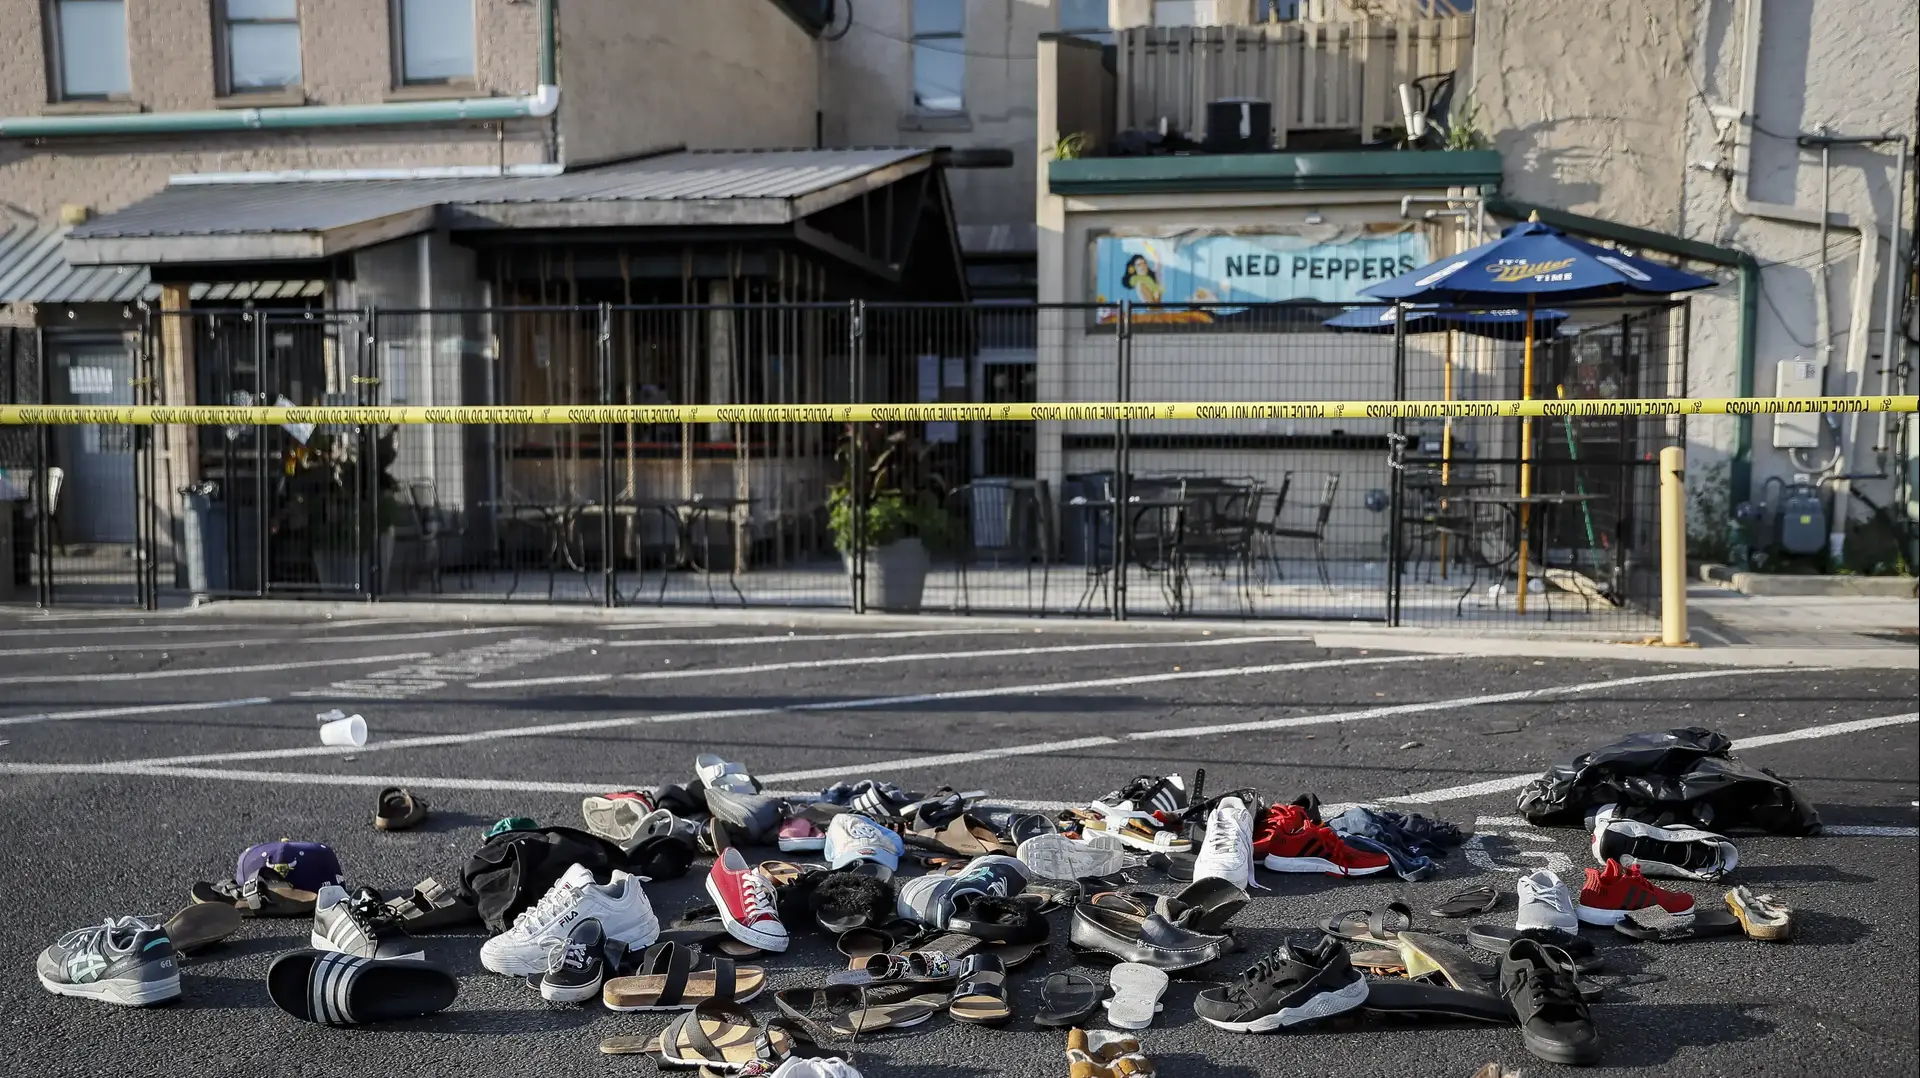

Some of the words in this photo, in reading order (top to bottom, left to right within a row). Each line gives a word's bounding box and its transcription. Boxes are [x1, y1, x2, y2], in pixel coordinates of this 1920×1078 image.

[1226, 255, 1280, 277] NED
[1292, 255, 1414, 280] PEPPERS
[1485, 257, 1576, 282] Miller
[1534, 273, 1573, 282] TIME
[1196, 406, 1228, 419] CROSS
[1231, 406, 1248, 419] NOT
[1251, 406, 1264, 418] DO
[1267, 405, 1288, 418] LINE
[1291, 405, 1324, 418] POLICE
[1366, 404, 1399, 417] CROSS
[1403, 404, 1420, 417] NOT
[1423, 404, 1437, 416] DO
[1440, 404, 1461, 416] LINE
[1465, 404, 1499, 416] POLICE
[1543, 403, 1576, 416] CROSS
[1580, 403, 1600, 416] NOT
[1603, 402, 1616, 416] DO
[1619, 402, 1641, 415] LINE
[1645, 402, 1681, 415] POLICE
[1725, 401, 1760, 414] CROSS
[1764, 401, 1784, 414] NOT
[1787, 400, 1801, 413] DO
[1805, 400, 1828, 412] LINE
[1832, 400, 1869, 412] POLICE
[717, 408, 745, 422] CROSS
[749, 408, 765, 422] NOT
[767, 408, 780, 422] DO
[782, 408, 801, 422] LINE
[802, 408, 833, 422] POLICE
[871, 407, 901, 421] CROSS
[904, 407, 920, 421] NOT
[923, 407, 936, 421] DO
[938, 407, 958, 421] LINE
[960, 407, 991, 421] POLICE
[1031, 406, 1061, 420] CROSS
[1065, 406, 1081, 420] NOT
[1085, 406, 1097, 420] DO
[1100, 406, 1120, 420] LINE
[1123, 406, 1155, 420] POLICE
[558, 910, 579, 928] FILA
[160, 959, 173, 968] GEL
